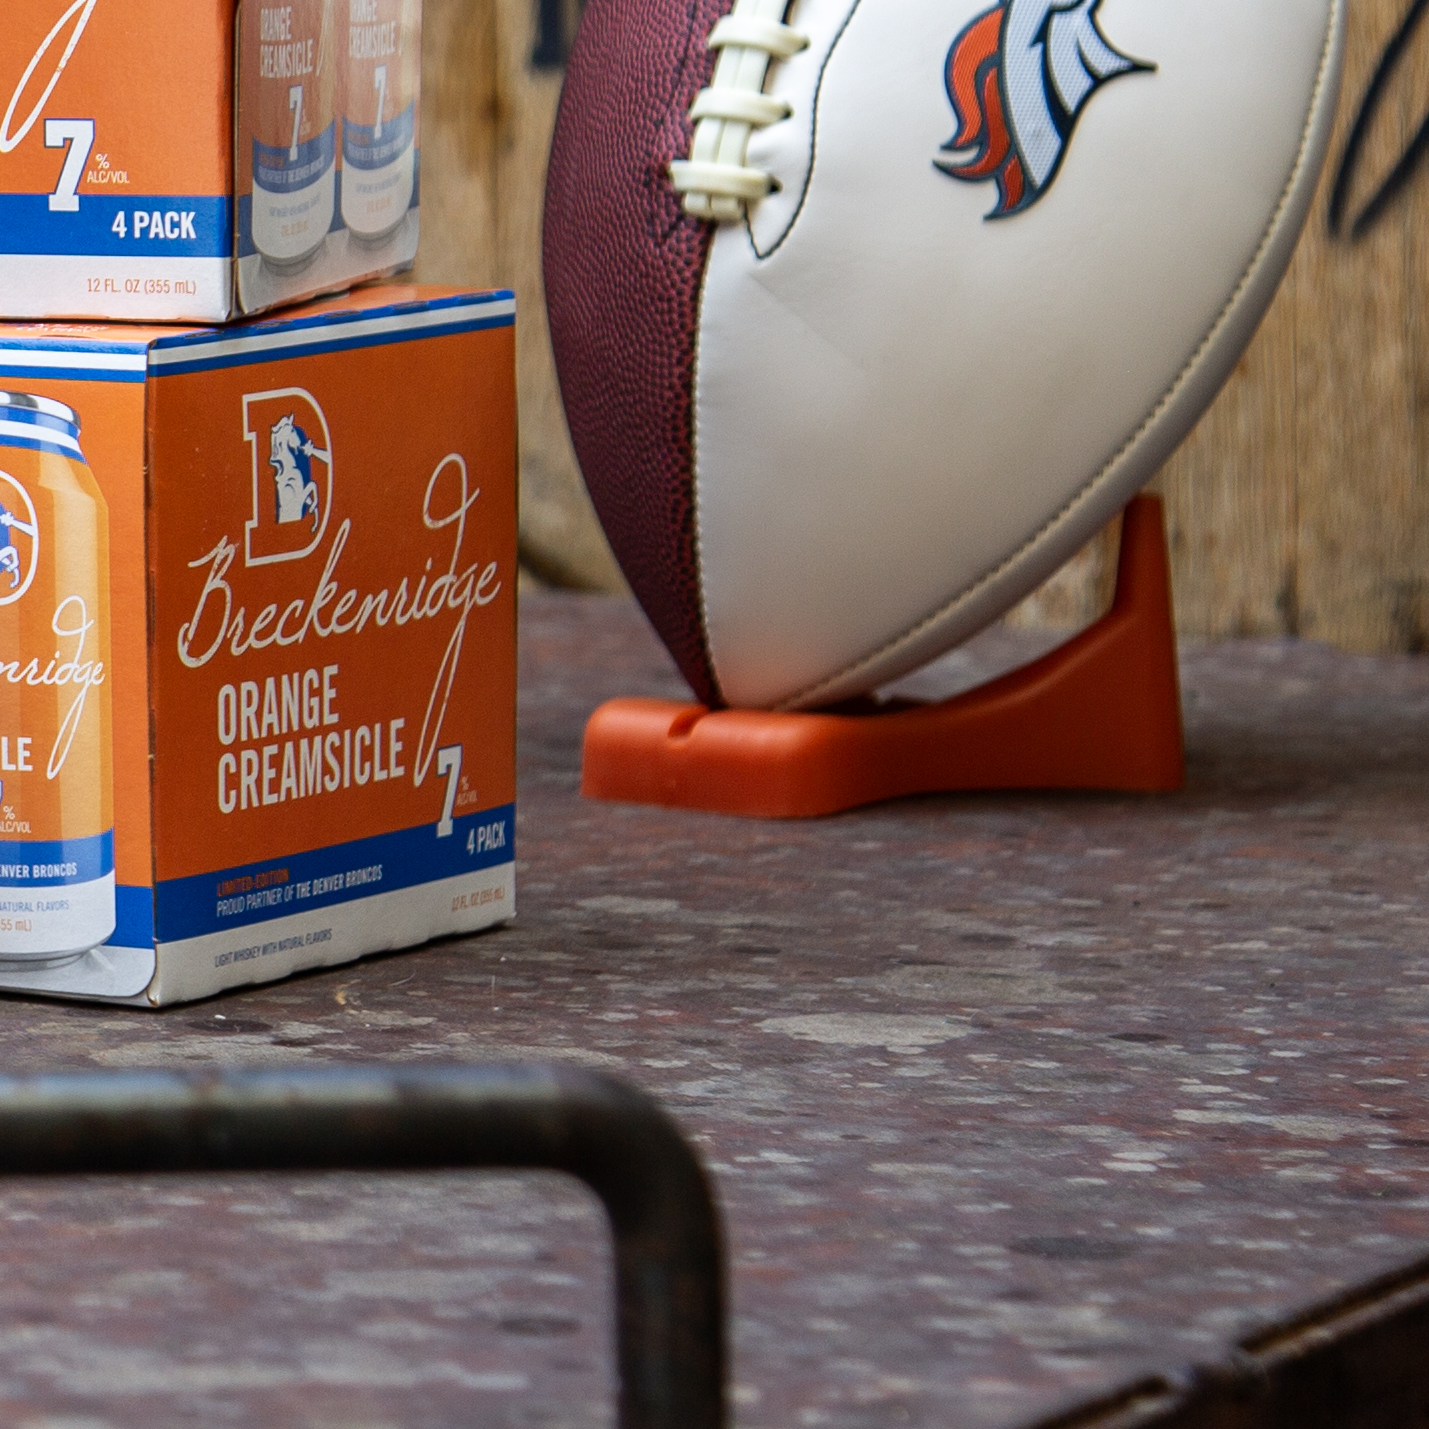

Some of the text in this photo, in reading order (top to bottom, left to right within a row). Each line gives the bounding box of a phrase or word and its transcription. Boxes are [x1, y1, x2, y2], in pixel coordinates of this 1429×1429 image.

[44, 117, 95, 212] 7
[86, 170, 130, 184] ALC/VOL
[111, 210, 197, 240] 4 PACK
[86, 278, 197, 296] 12 FL. OZ (355 mL)
[177, 452, 502, 788] Breckenridge
[217, 664, 339, 746] ORANGE
[217, 718, 405, 814] CREAMSICLE
[436, 743, 463, 839] 7
[466, 821, 506, 855] 4 PACK
